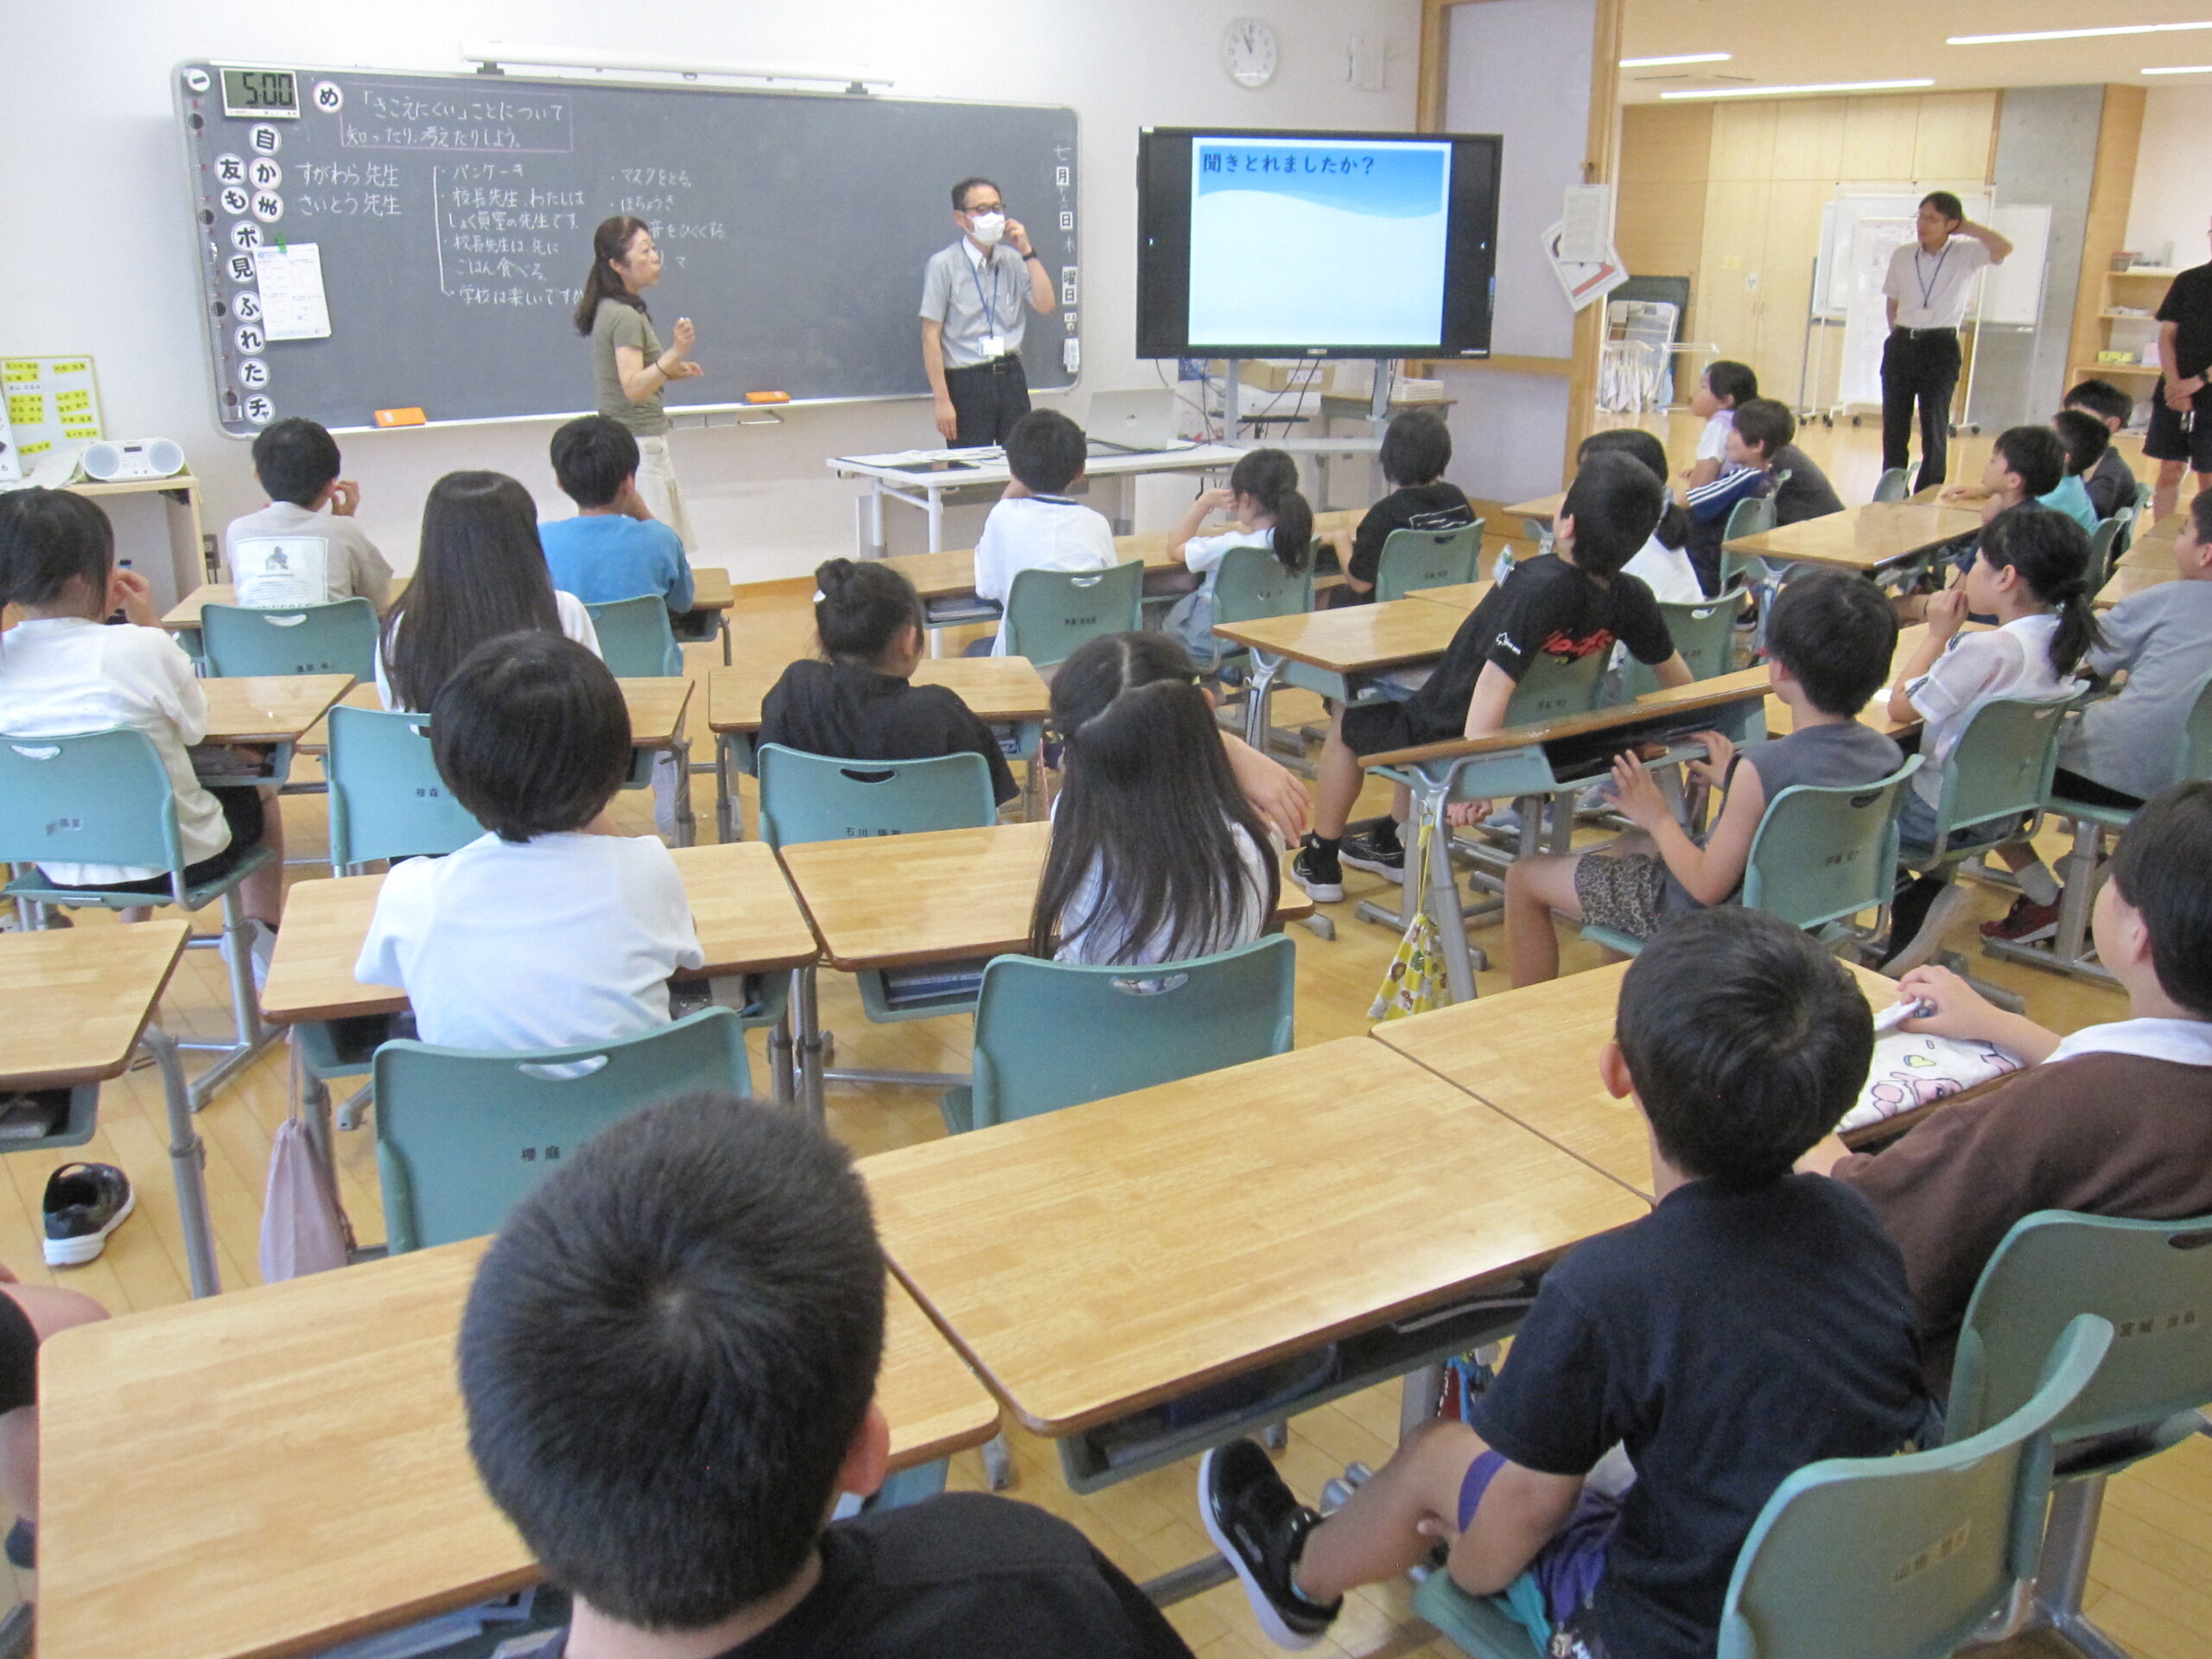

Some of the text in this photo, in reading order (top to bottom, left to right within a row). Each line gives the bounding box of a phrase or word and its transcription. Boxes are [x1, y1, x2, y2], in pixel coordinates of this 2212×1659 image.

[320, 87, 339, 106] め
[256, 129, 275, 150] 自
[220, 159, 241, 180] 友
[257, 164, 276, 183] か
[1204, 153, 1374, 175] 聞きとれましたか？
[225, 190, 246, 209] も
[300, 192, 402, 216] さいとう先生
[232, 257, 253, 278] 見
[241, 297, 259, 316] ふ
[240, 330, 262, 349] れ
[245, 364, 264, 382] た
